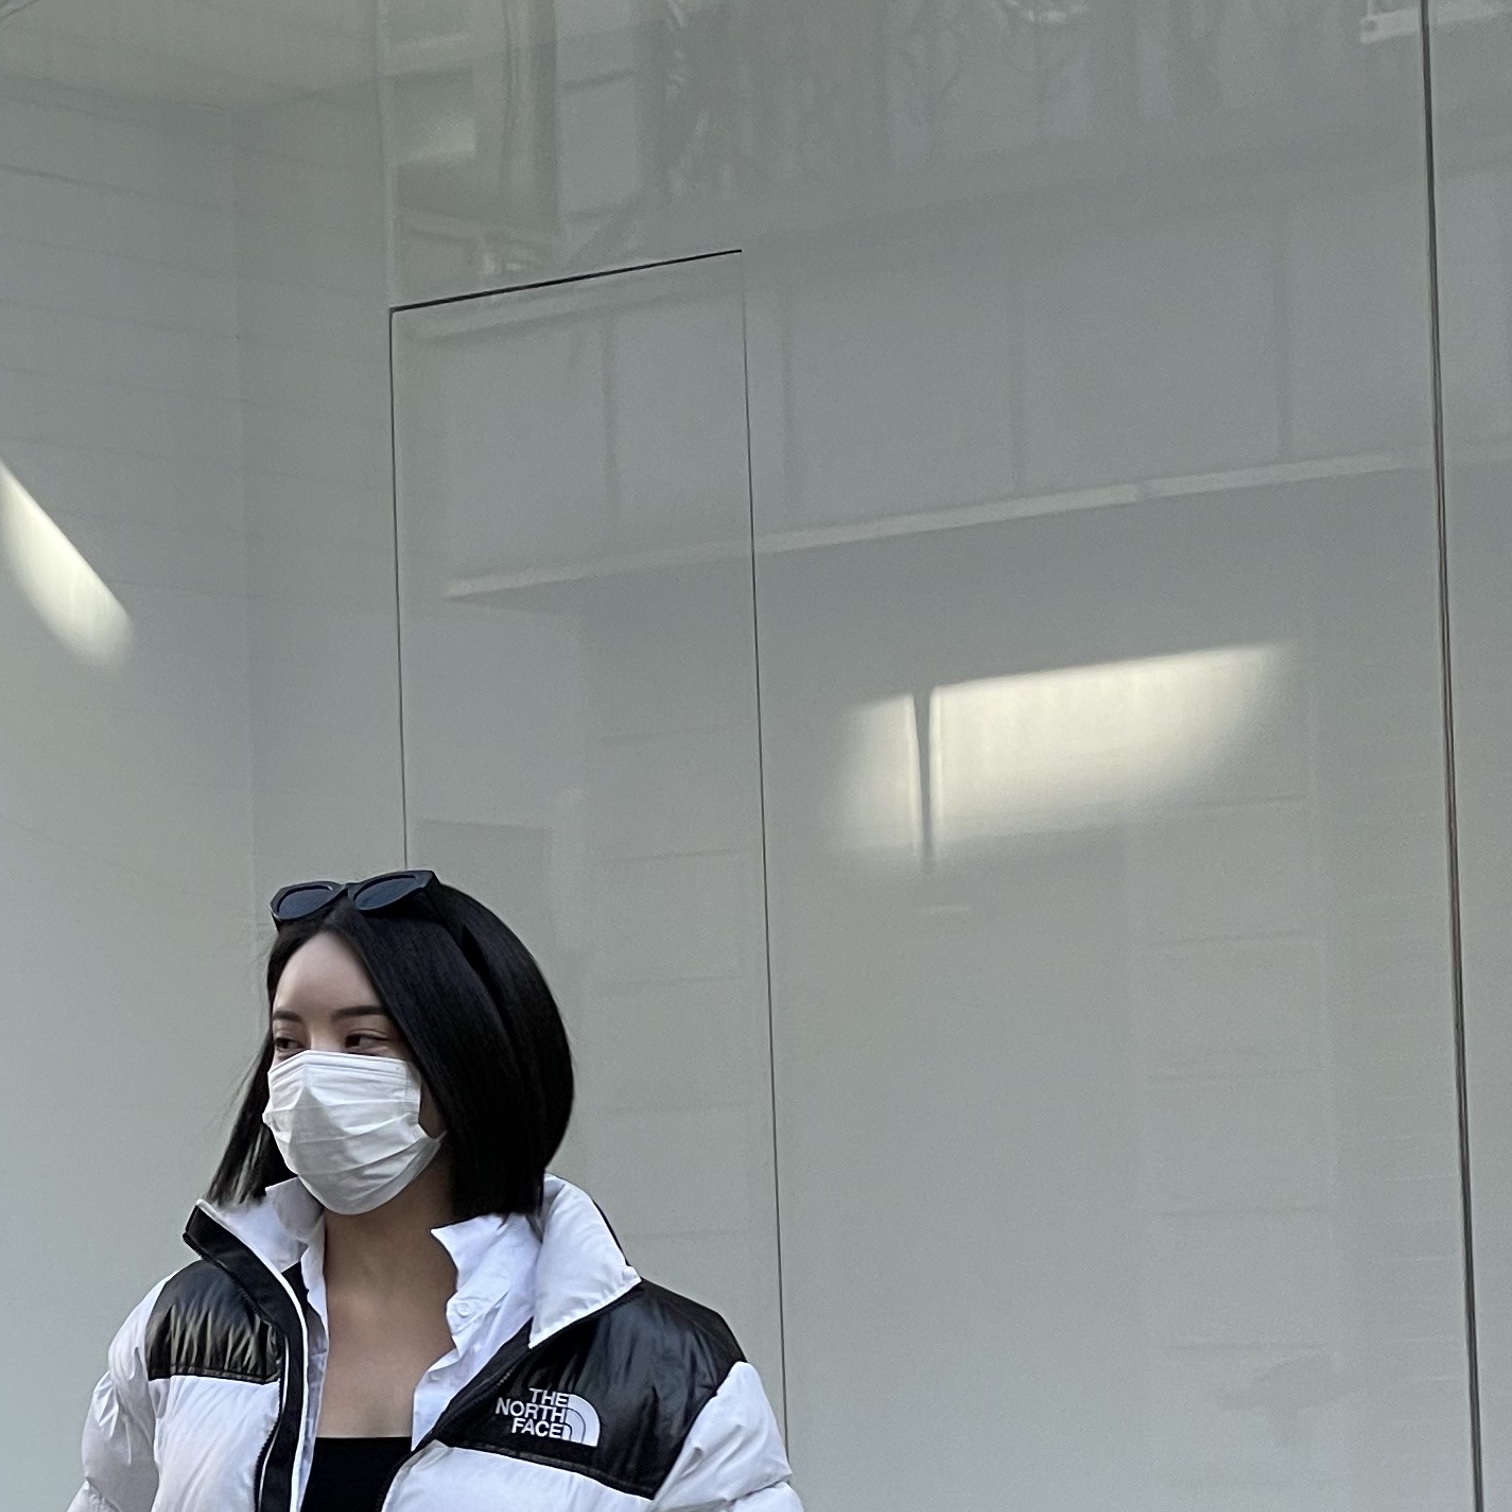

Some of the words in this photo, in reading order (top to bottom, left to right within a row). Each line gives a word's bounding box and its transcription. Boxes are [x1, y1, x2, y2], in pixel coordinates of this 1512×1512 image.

[529, 1388, 569, 1407] THE
[495, 1397, 566, 1423] NORTH
[511, 1417, 564, 1439] FACE
